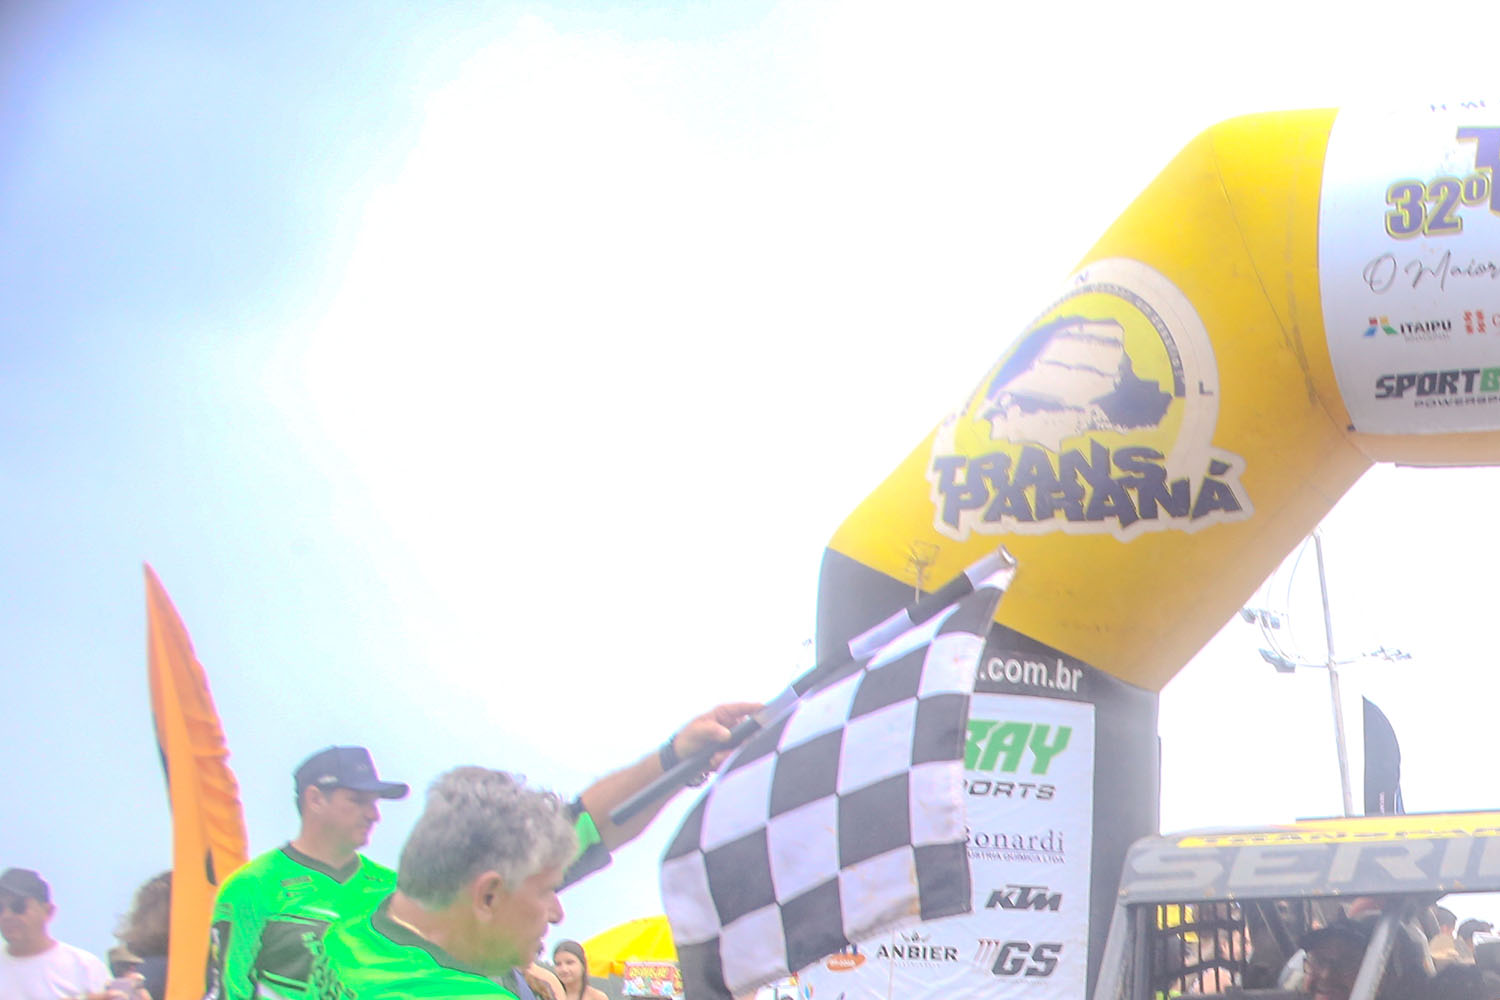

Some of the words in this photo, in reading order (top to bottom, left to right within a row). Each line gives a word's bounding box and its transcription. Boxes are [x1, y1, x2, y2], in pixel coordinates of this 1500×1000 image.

[1362, 253, 1397, 294] O
[1400, 319, 1452, 334] ITAIPU
[933, 439, 1168, 492] TRANS
[938, 459, 1244, 531] PARANÁ
[963, 780, 1056, 801] ORTS
[985, 885, 1064, 911] KTM
[876, 943, 960, 962] ANBIER
[990, 942, 1064, 978] GS
